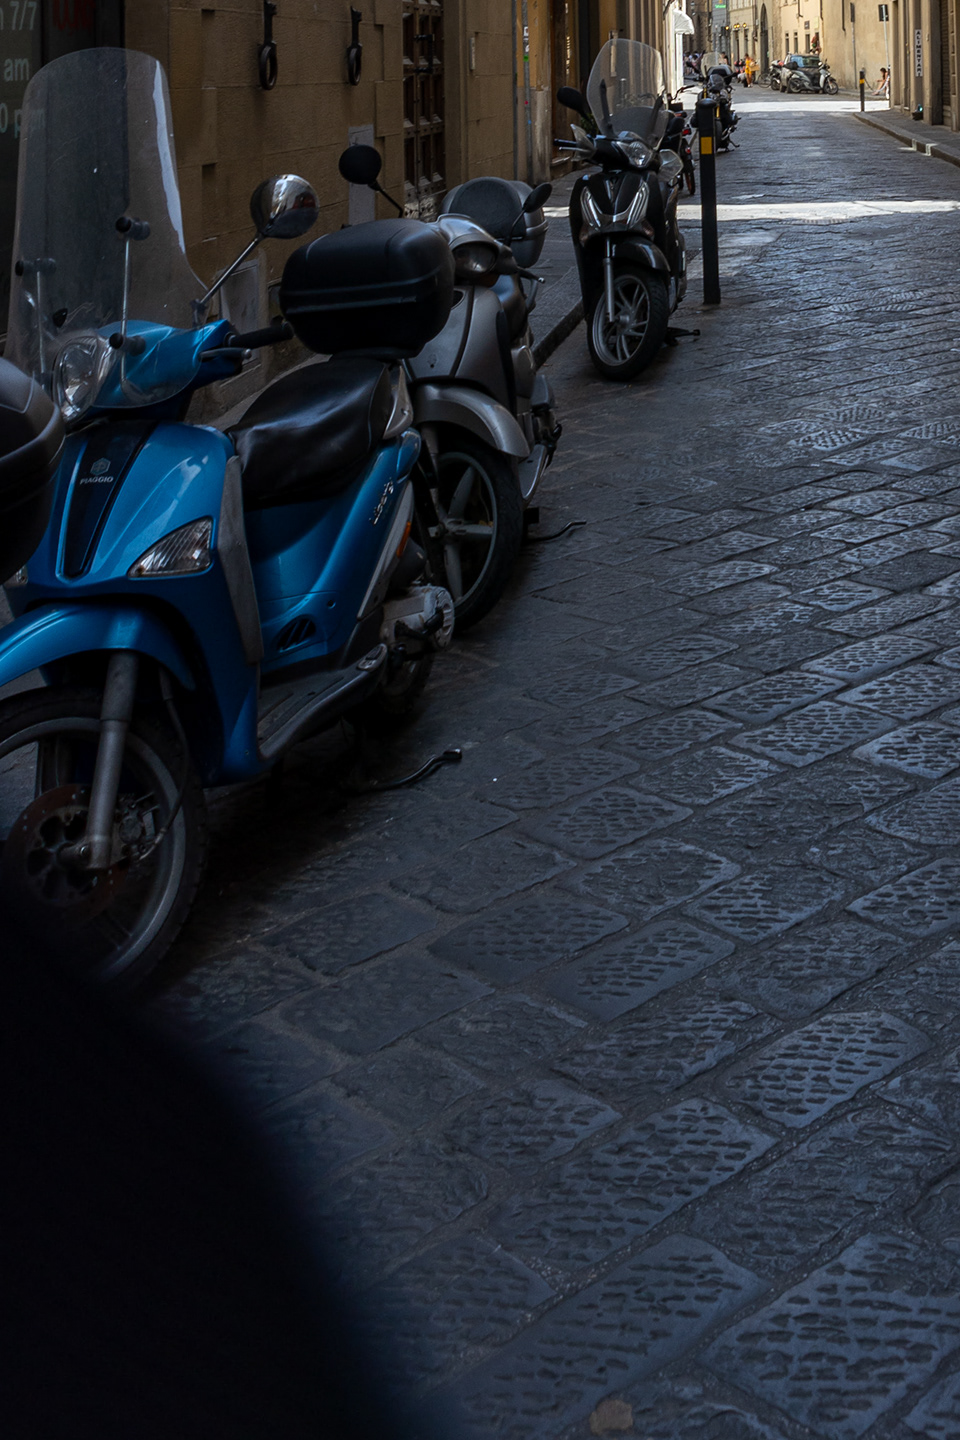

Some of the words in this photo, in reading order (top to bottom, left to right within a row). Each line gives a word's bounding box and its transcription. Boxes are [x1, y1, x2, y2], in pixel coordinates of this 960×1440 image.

[9, 0, 38, 31] 7/7
[4, 58, 29, 82] am
[79, 475, 114, 485] PIAGGIO
